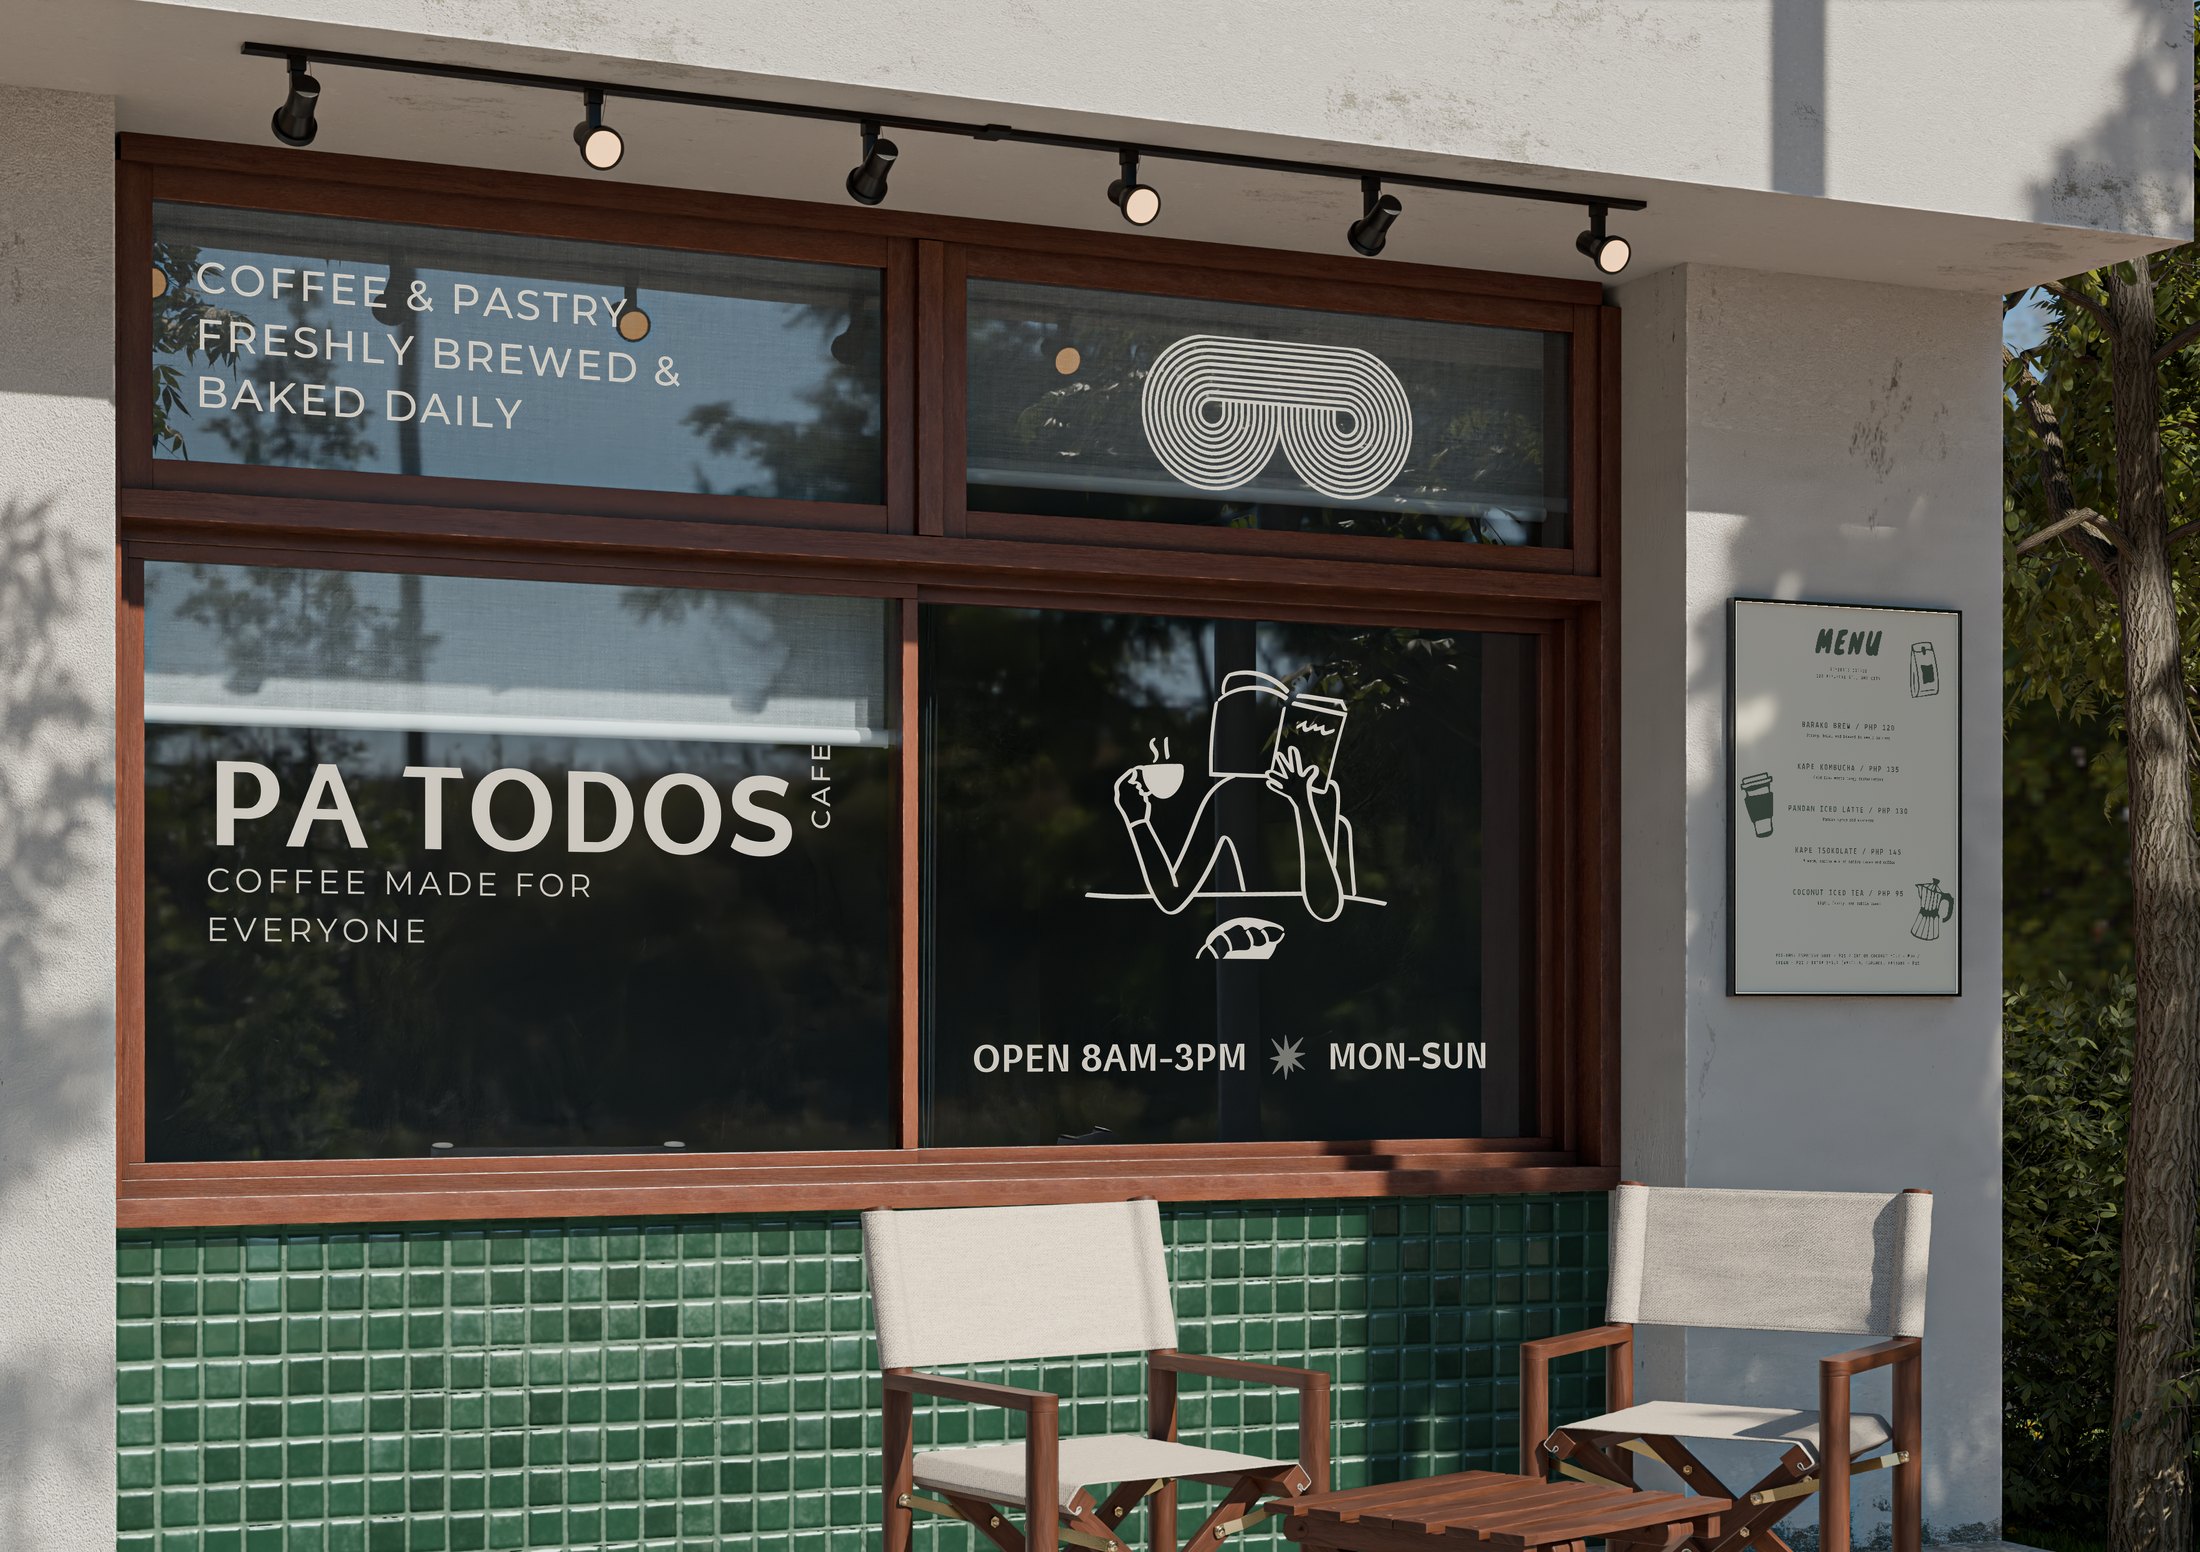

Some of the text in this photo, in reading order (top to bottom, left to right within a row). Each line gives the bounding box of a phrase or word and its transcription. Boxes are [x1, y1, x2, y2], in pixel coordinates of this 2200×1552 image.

[198, 263, 627, 327] COFFEE & PASTRY
[200, 319, 679, 386] FRESHLY BREWED &
[200, 377, 522, 428] BAKED DAILY
[1815, 628, 1882, 656] MENU
[1801, 720, 1829, 729] BARAKO
[1832, 722, 1851, 730] BREW
[1864, 723, 1878, 731] PHP
[1882, 724, 1895, 732] 120
[1797, 762, 1815, 770] KAPE
[1819, 763, 1855, 772] KOMBUCHA
[1868, 765, 1882, 773] PHP
[1886, 765, 1900, 774] 135
[812, 746, 830, 828] CAFE
[217, 761, 792, 856] PA TODOS
[1787, 804, 1816, 813] PANDAN
[1819, 804, 1838, 813] ICED
[1842, 805, 1864, 814] LATTE
[1895, 807, 1908, 815] 130
[1794, 846, 1813, 854] KAPE
[1817, 846, 1857, 855] TSOKOLATE
[1870, 848, 1884, 856] PHP
[1888, 848, 1902, 856] 145
[208, 869, 589, 897] COFFEE MADE FOR
[1792, 888, 1824, 896] COCONUT
[1828, 888, 1847, 897] ICED
[1851, 889, 1865, 897] TEA
[1877, 889, 1891, 897] PHP
[210, 918, 424, 942] EVERYONE
[974, 1043, 1485, 1072] OPEN 8AM-3PM MON-SUN
